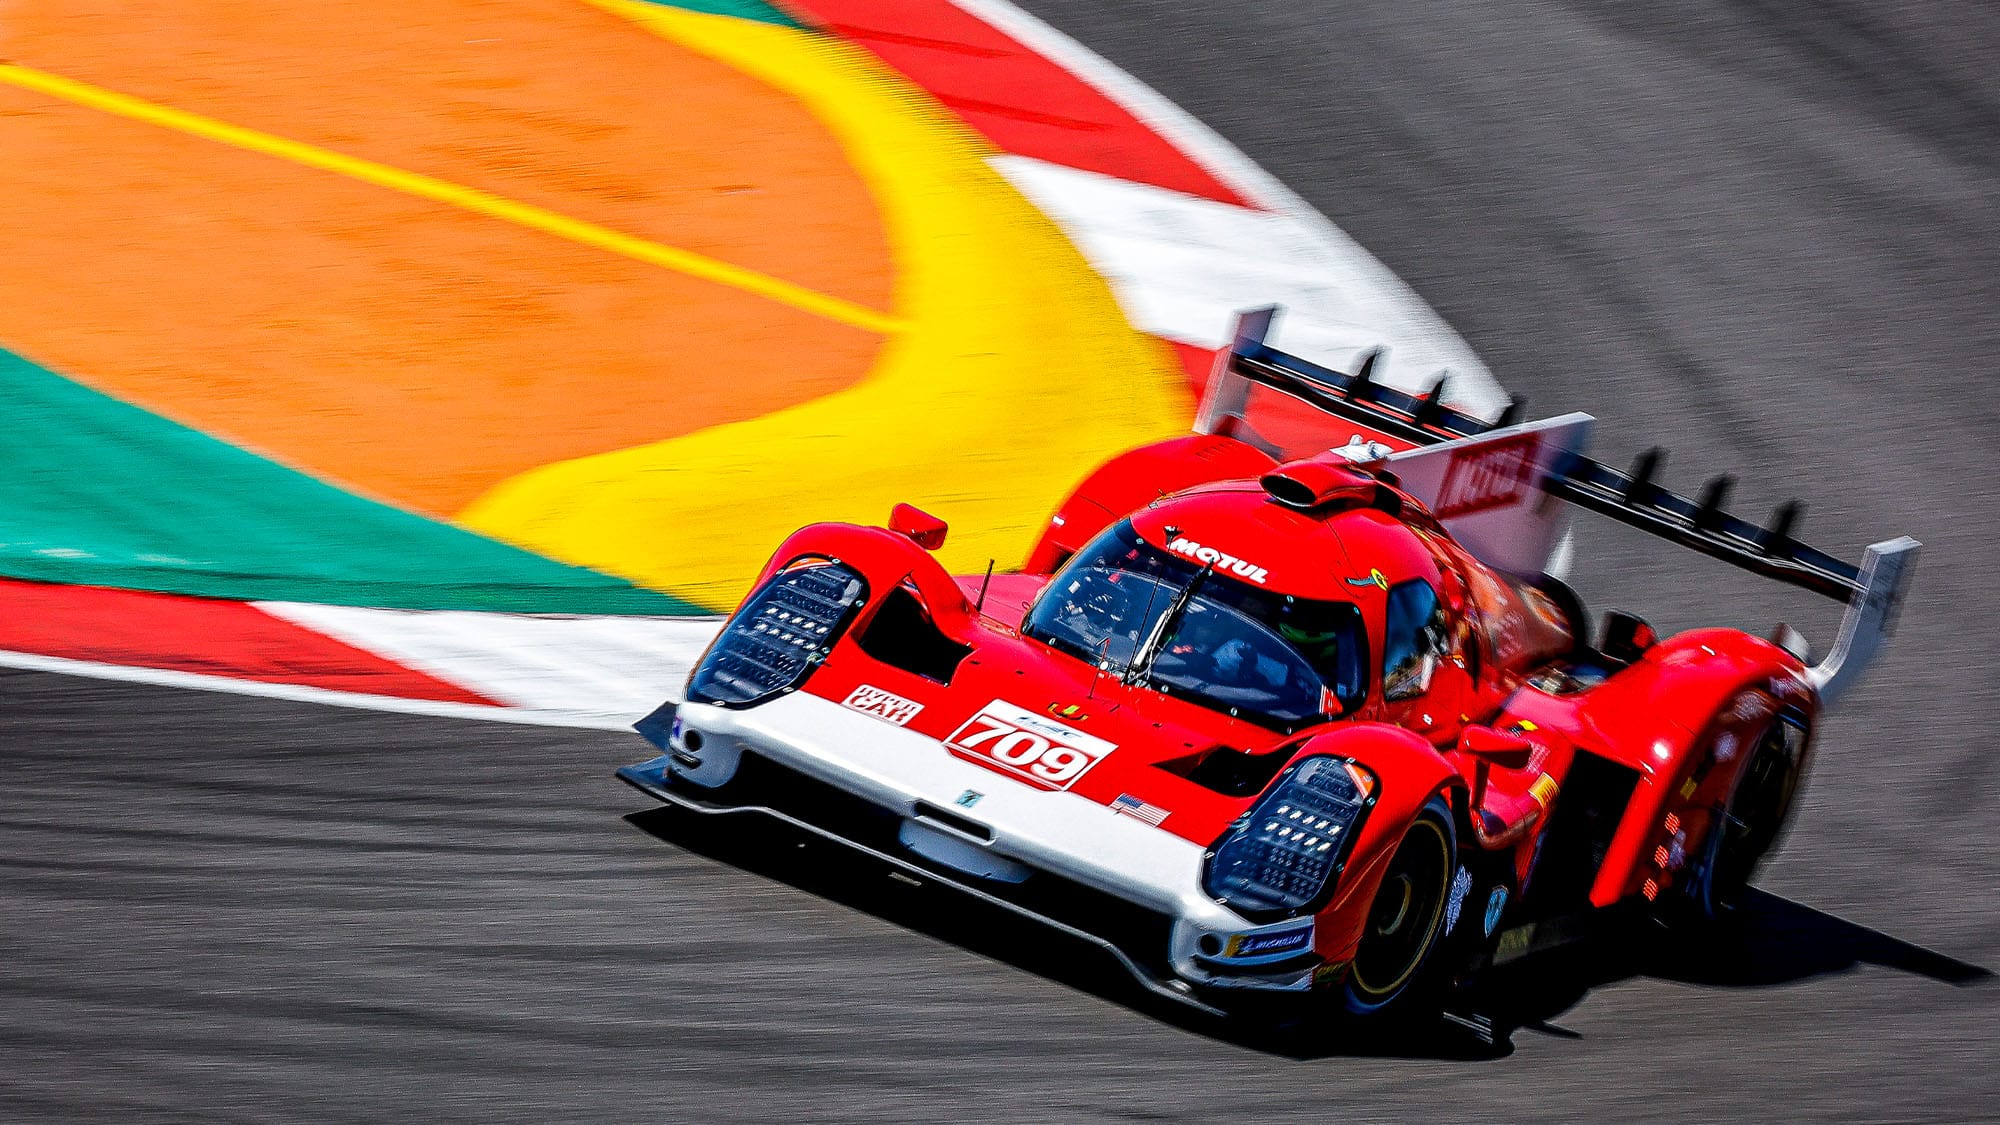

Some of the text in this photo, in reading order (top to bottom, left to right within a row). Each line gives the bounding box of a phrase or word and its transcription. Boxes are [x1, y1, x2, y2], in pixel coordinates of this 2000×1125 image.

[1166, 538, 1269, 584] MOTUL
[849, 694, 909, 723] CAR
[957, 714, 1089, 782] 709
